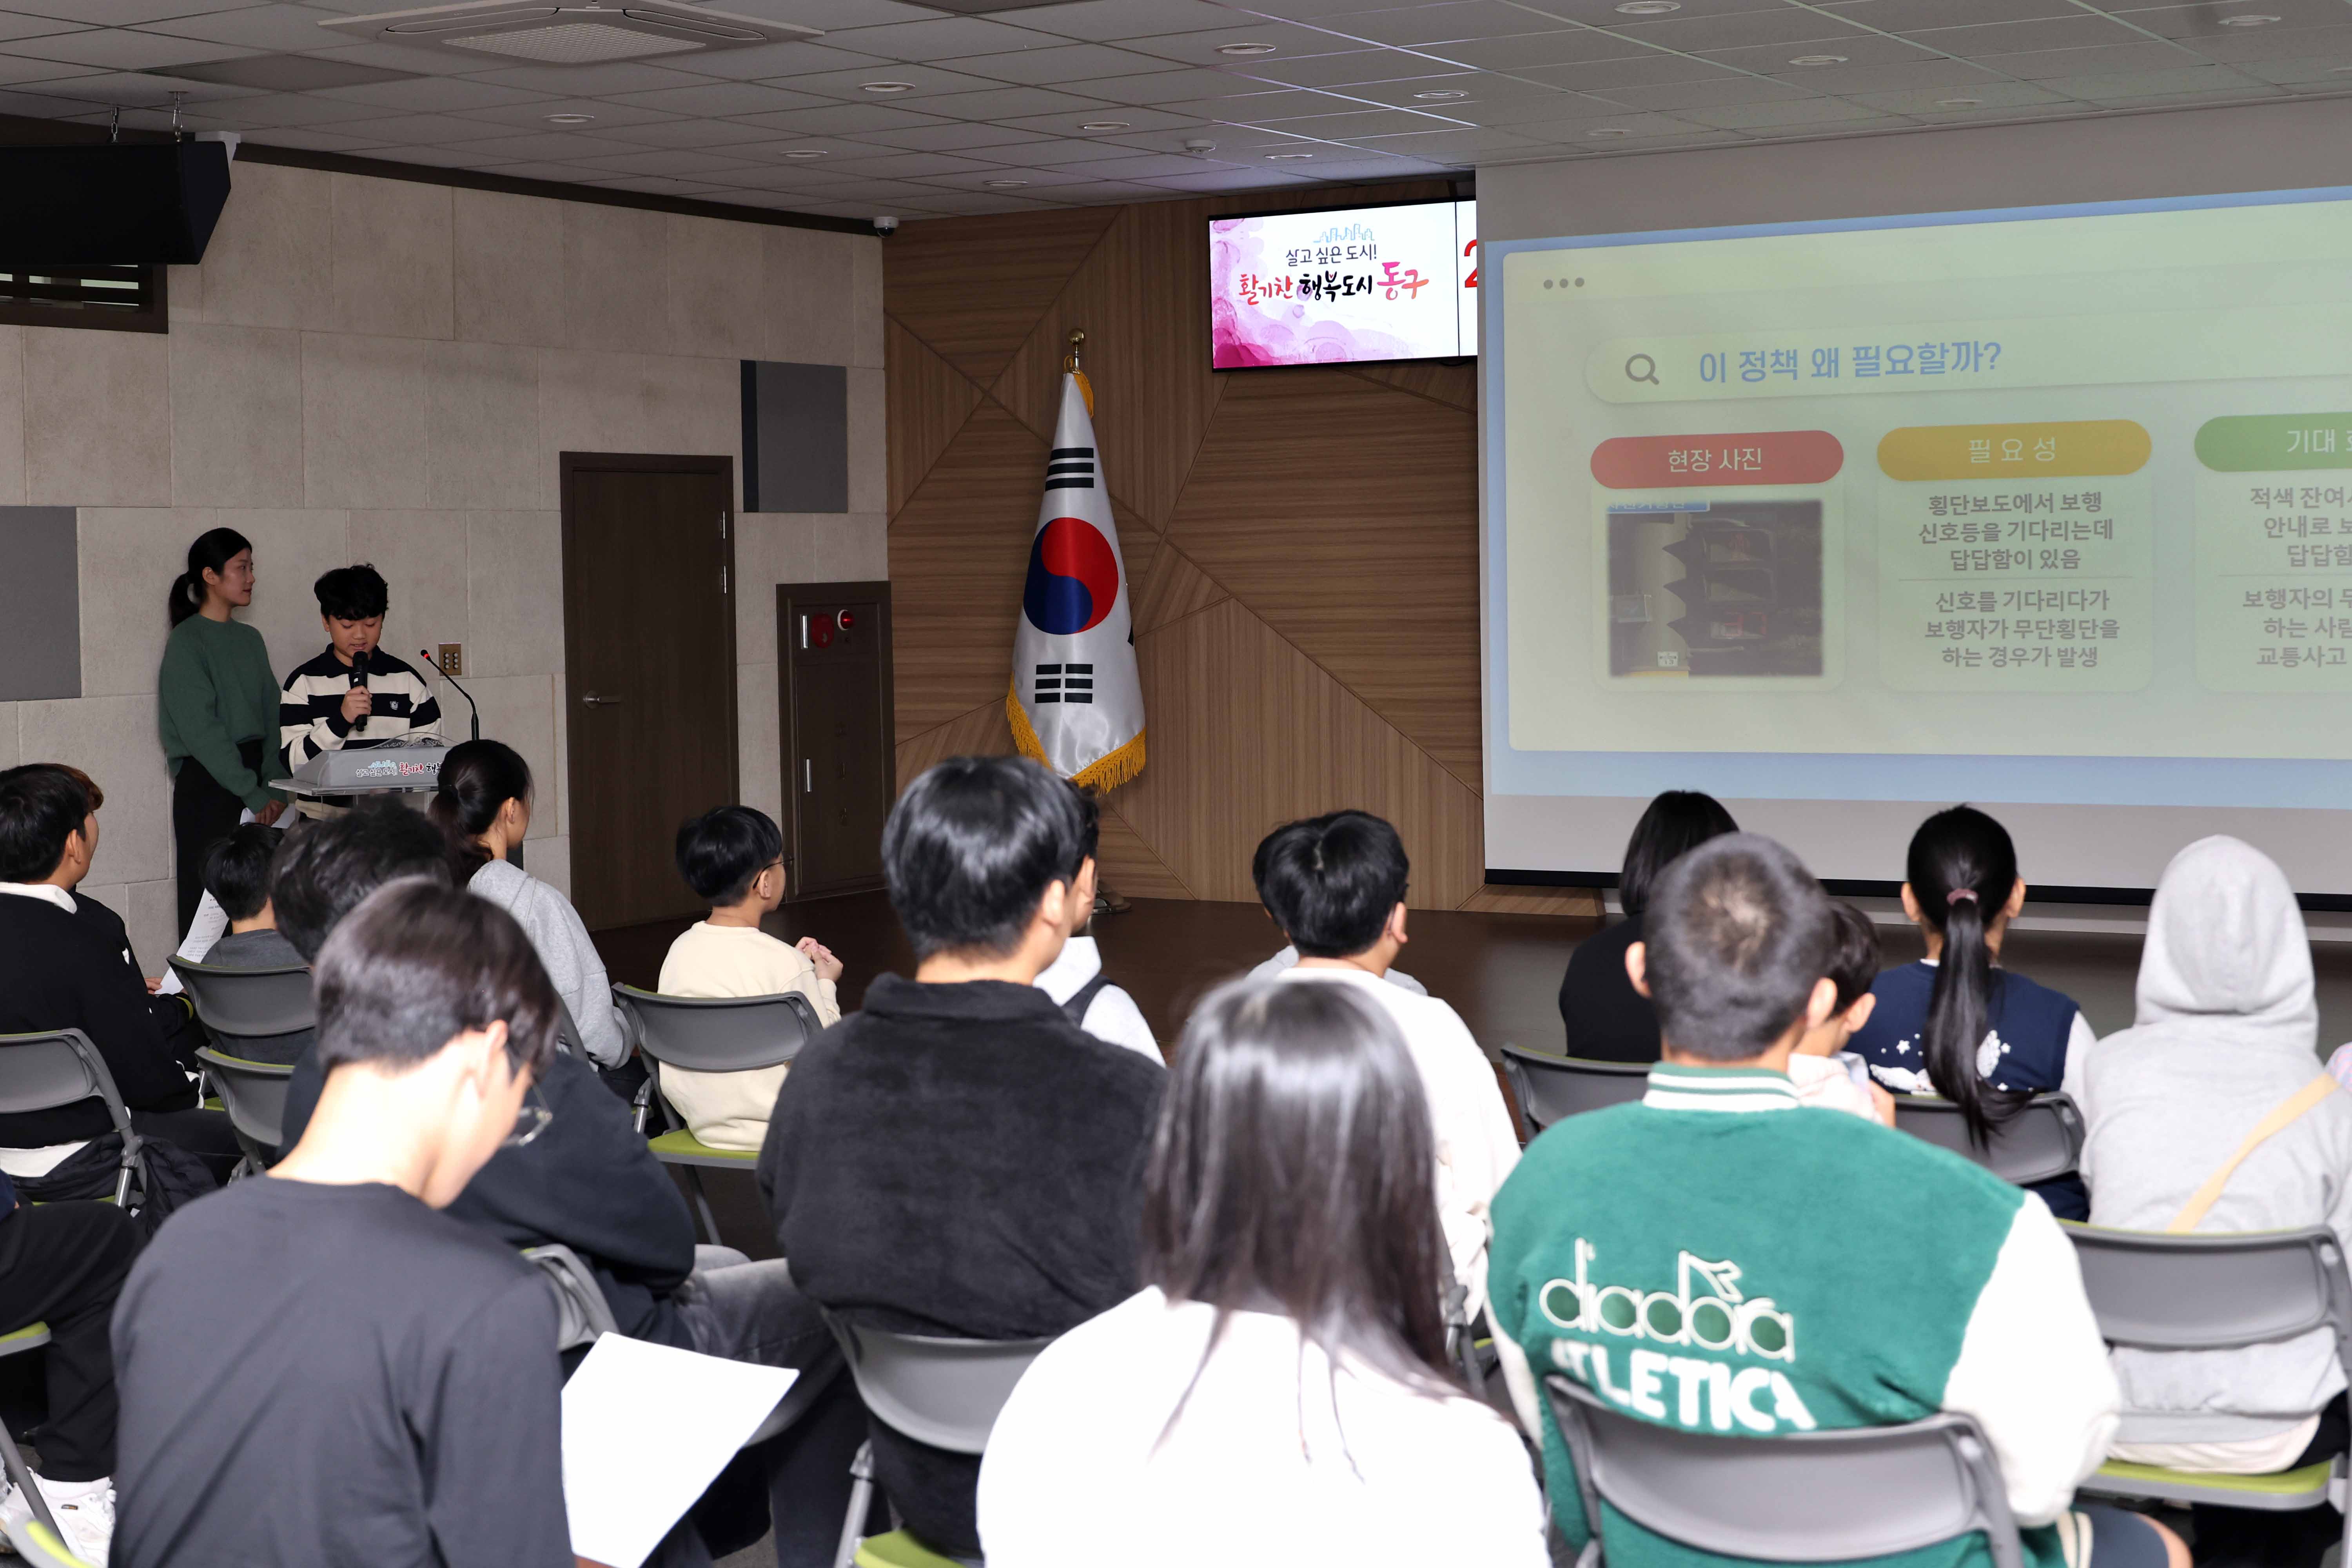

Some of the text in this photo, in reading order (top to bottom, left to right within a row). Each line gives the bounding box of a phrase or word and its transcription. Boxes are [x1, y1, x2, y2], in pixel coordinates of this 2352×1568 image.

[1286, 244, 1376, 267] 살고 싶은 도시!
[1239, 261, 1429, 305] 활기찬 행복도시 동구
[1700, 341, 2001, 383] 이 정책 왜 필요할까?
[2287, 428, 2335, 453] 기대
[1668, 448, 1762, 472] 현장 사진
[1928, 491, 2102, 516] 횡단보도에서 보행
[2250, 486, 2352, 509] 적색 잔여
[1918, 519, 2113, 544] 신호등을 기다리는데
[2264, 515, 2332, 538] 안내로
[1950, 549, 2081, 571] 답답함이 있음
[1936, 589, 2110, 613] 신호를 기다리다가
[2243, 588, 2332, 610] 보행자의
[1925, 618, 2120, 640] 보행자가 무단횡단을
[2263, 617, 2308, 638] 하는
[1942, 646, 2098, 668] 하는 경우가 발생
[2257, 646, 2347, 668] 교통사고
[399, 762, 424, 776] 활기찬
[1539, 1237, 1795, 1363] diadora
